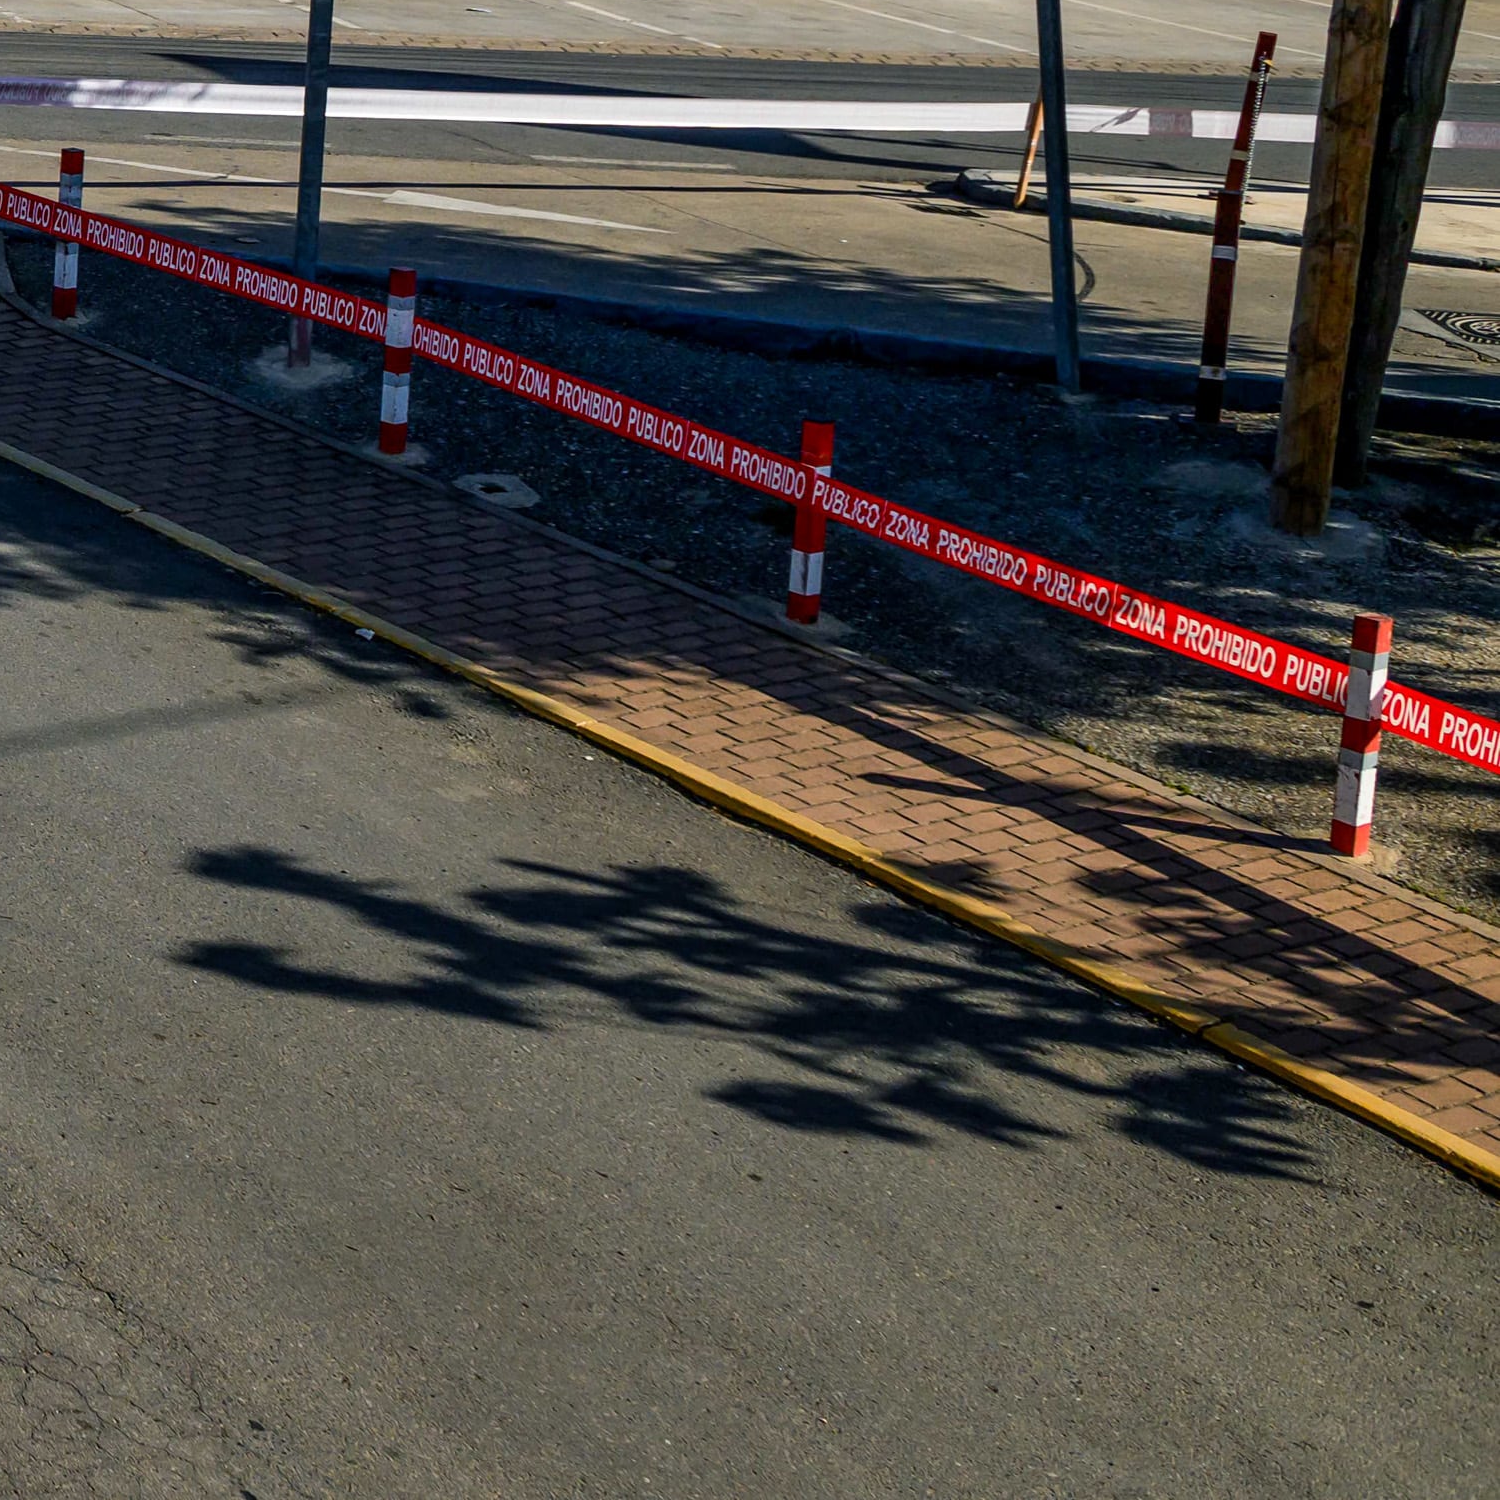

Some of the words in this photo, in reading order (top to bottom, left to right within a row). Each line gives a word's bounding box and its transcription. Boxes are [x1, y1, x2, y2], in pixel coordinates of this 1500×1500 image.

[6, 193, 50, 229] PUBLICO
[53, 206, 82, 238] ZONA
[87, 219, 144, 259] PROHIBIDO
[148, 236, 195, 275] PUBLICO
[199, 254, 231, 284] ZONA
[235, 267, 298, 307] PROHIBIDO
[303, 287, 355, 327] PUBLICO
[413, 323, 458, 362] OHIBIDO
[464, 344, 513, 387] PUBLICO
[517, 363, 550, 401] ZONA
[555, 378, 622, 429] PROHIBIDO
[627, 407, 683, 451] PUBLICO
[687, 428, 724, 470] ZONA
[730, 446, 805, 499] PROHIBIDO
[811, 479, 879, 529] PUBLICO
[884, 509, 929, 552] ZONA
[936, 529, 1027, 585] PROHIBIDO
[1033, 565, 1109, 617] PUBLICO
[1114, 593, 1165, 641] ZONA
[1173, 614, 1276, 680] PROHIBIDO
[1283, 654, 1348, 707] PUBLIC
[1382, 688, 1429, 739] ZONA
[1439, 713, 1500, 768] PROHI
